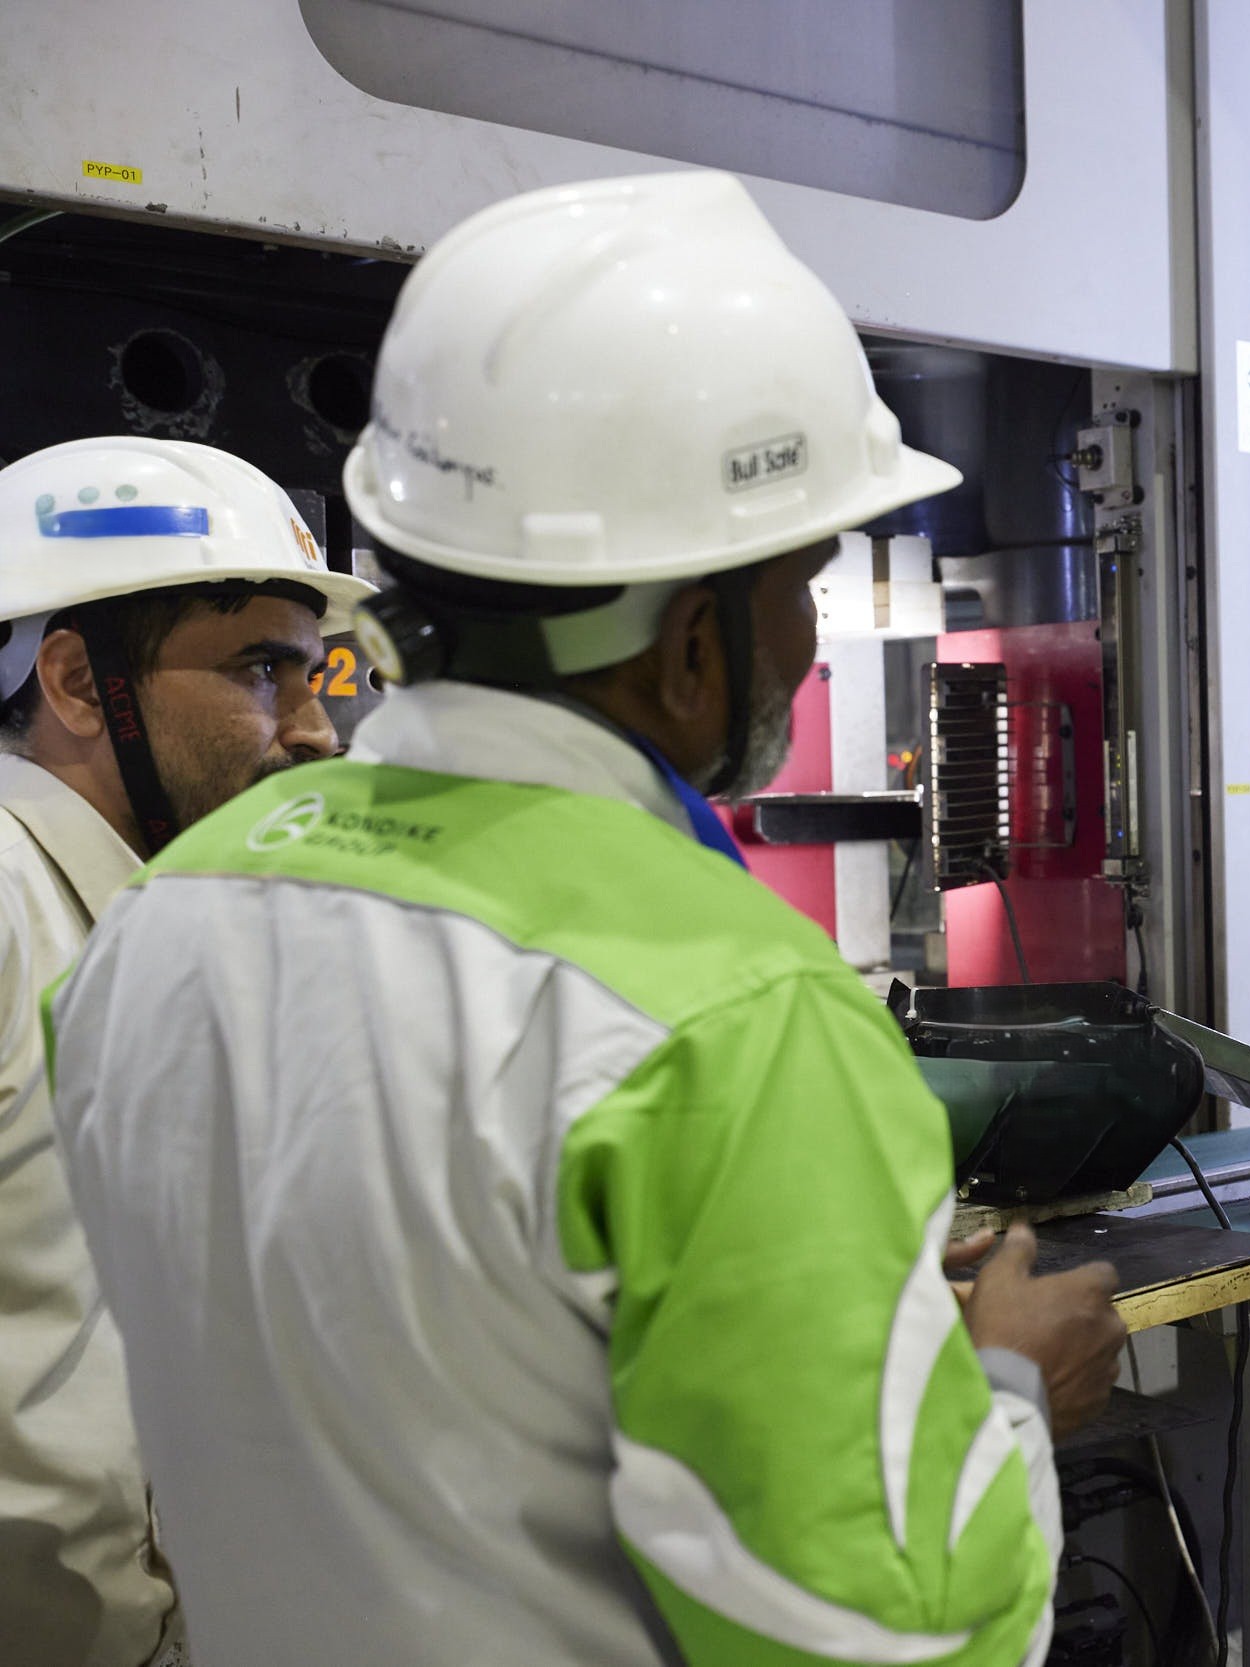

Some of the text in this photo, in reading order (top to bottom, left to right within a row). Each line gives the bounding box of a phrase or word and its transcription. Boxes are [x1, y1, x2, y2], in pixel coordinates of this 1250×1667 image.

[87, 163, 136, 181] PYP-01
[731, 452, 757, 482] Bull
[104, 676, 141, 743] ACME
